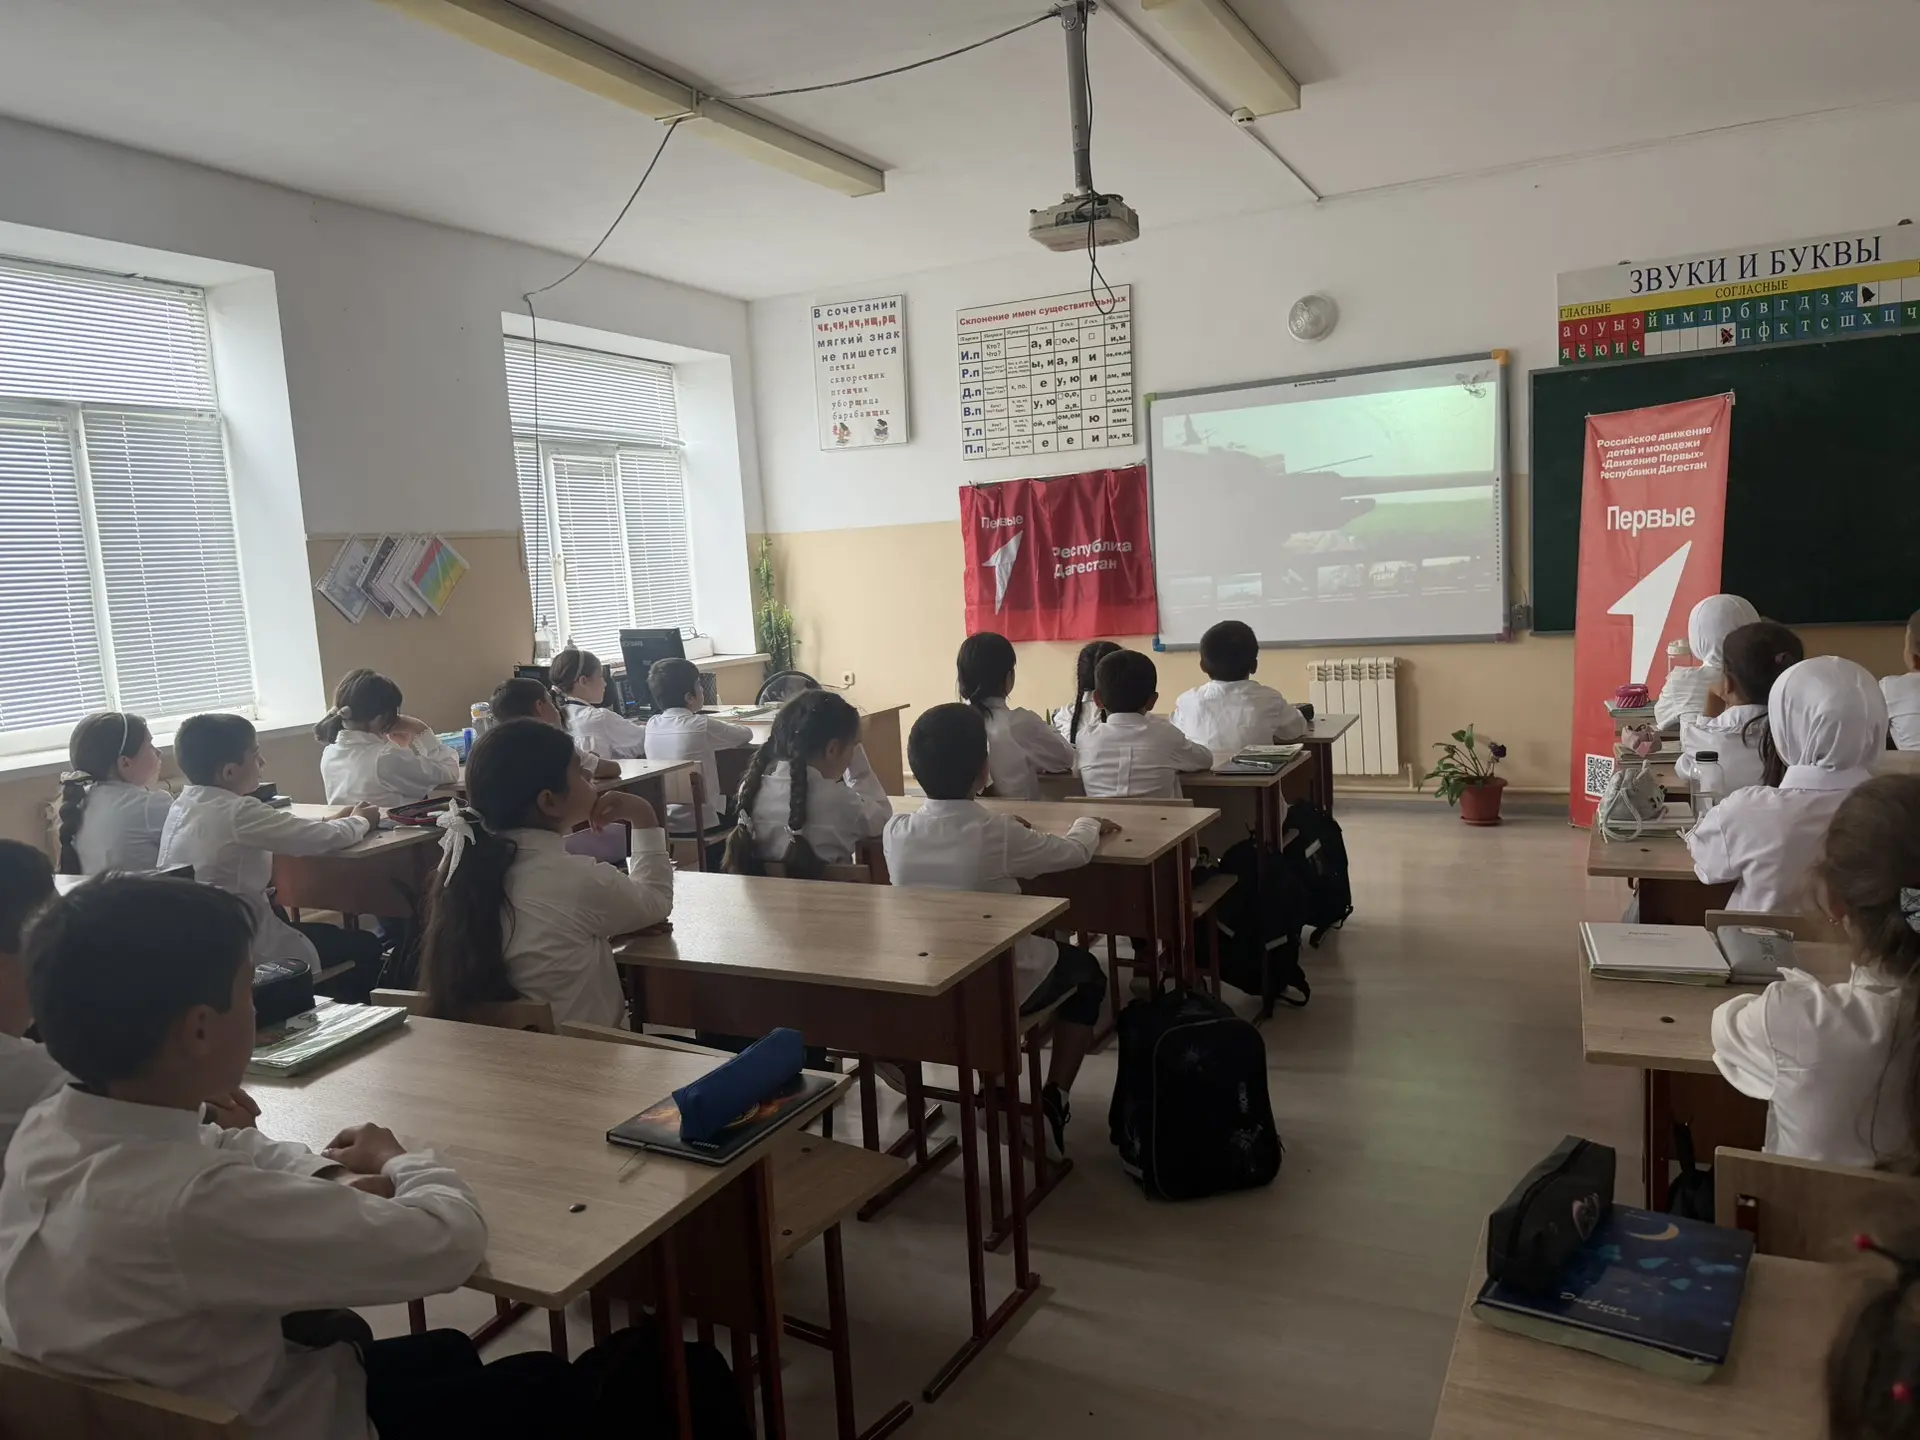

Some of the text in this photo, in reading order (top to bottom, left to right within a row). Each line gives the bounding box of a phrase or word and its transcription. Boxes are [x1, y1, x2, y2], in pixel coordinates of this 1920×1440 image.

[1630, 236, 1881, 293] ЗВУКИ И БУКВЫ
[1716, 280, 1788, 298] СОГЛАСНЫЕ
[814, 300, 896, 318] В сочетании
[960, 313, 1010, 325] Склонение
[1012, 308, 1036, 318] имен
[1560, 303, 1611, 319] ГЛАСНЫЕ
[1563, 291, 1854, 337] а о у ы э й н м л р б в г д з ж
[818, 330, 900, 348] мягкий знак
[1563, 307, 1916, 359] я ё ю и е п ф к т с ш х ц ч
[822, 346, 897, 362] не пишется
[961, 351, 979, 360] И.п
[830, 373, 885, 384] скворечник
[962, 369, 979, 378] Р.п
[831, 387, 868, 396] птенчик
[963, 388, 981, 399] Д.п
[832, 398, 878, 410] уборщица
[964, 407, 981, 416] В.п
[833, 409, 890, 420] барабанщик
[965, 428, 982, 436] Т.п
[1597, 426, 1712, 448] Российское движение
[965, 445, 983, 454] П.п
[1606, 446, 1636, 458] детей
[1646, 440, 1700, 453] молодежи
[1601, 461, 1707, 479] Республики Дагестан
[1607, 506, 1695, 537] Первые
[1054, 558, 1117, 579] Дагестан
